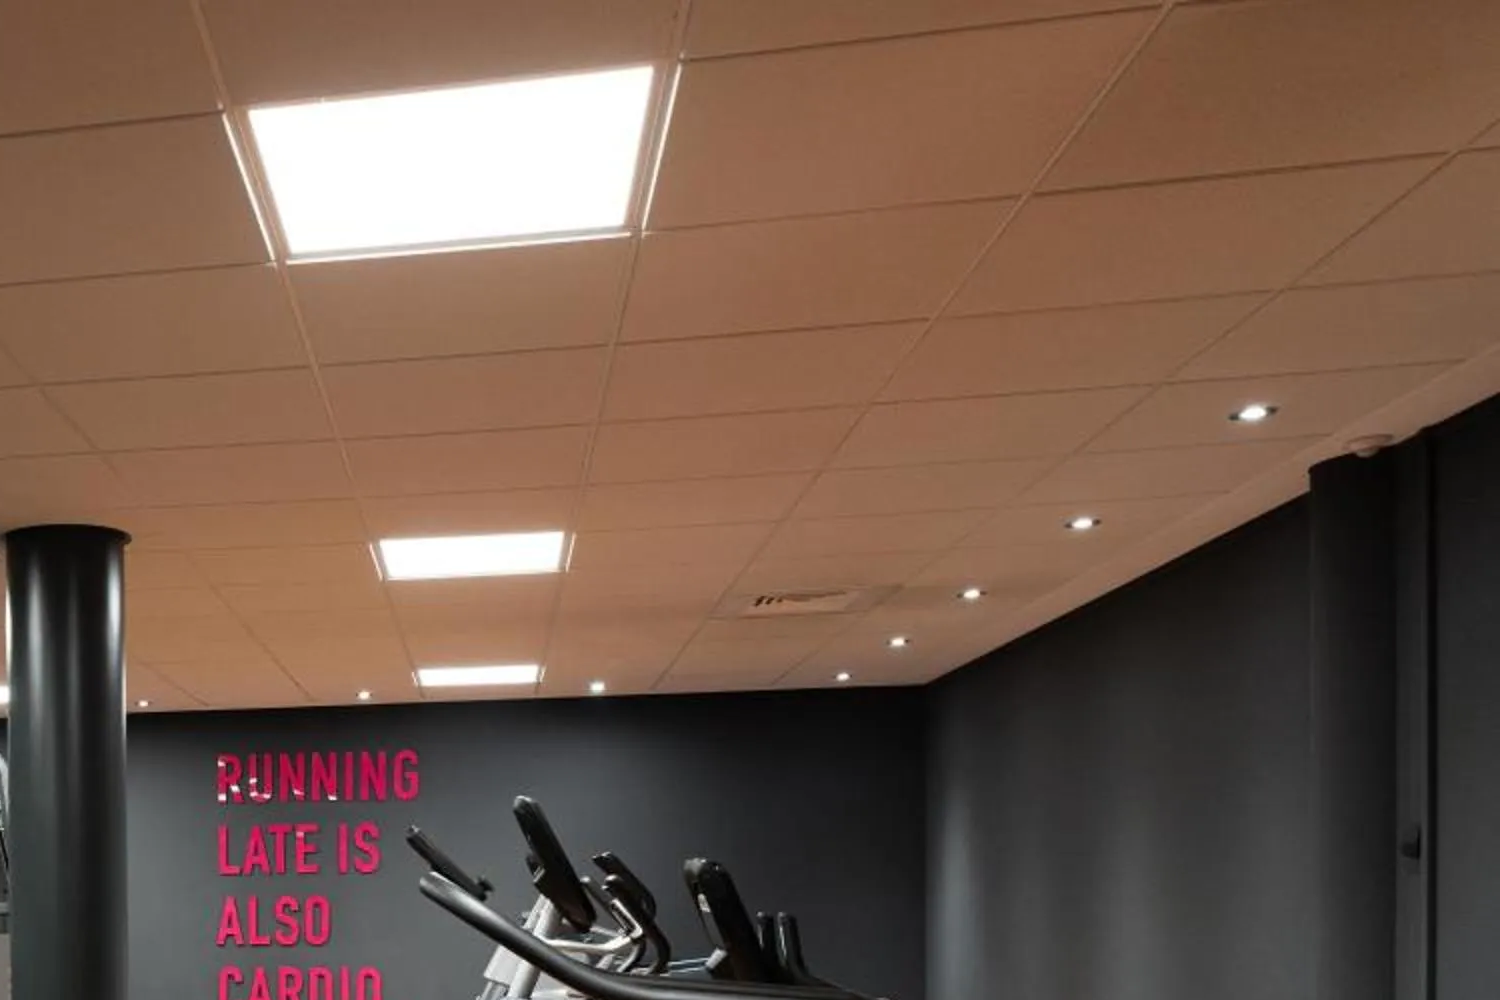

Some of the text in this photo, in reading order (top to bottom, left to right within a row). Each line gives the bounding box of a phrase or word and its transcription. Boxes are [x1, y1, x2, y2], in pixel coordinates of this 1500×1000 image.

[215, 749, 420, 803] RUNNING
[216, 821, 382, 877] LATE IS
[214, 894, 331, 948] ALSO
